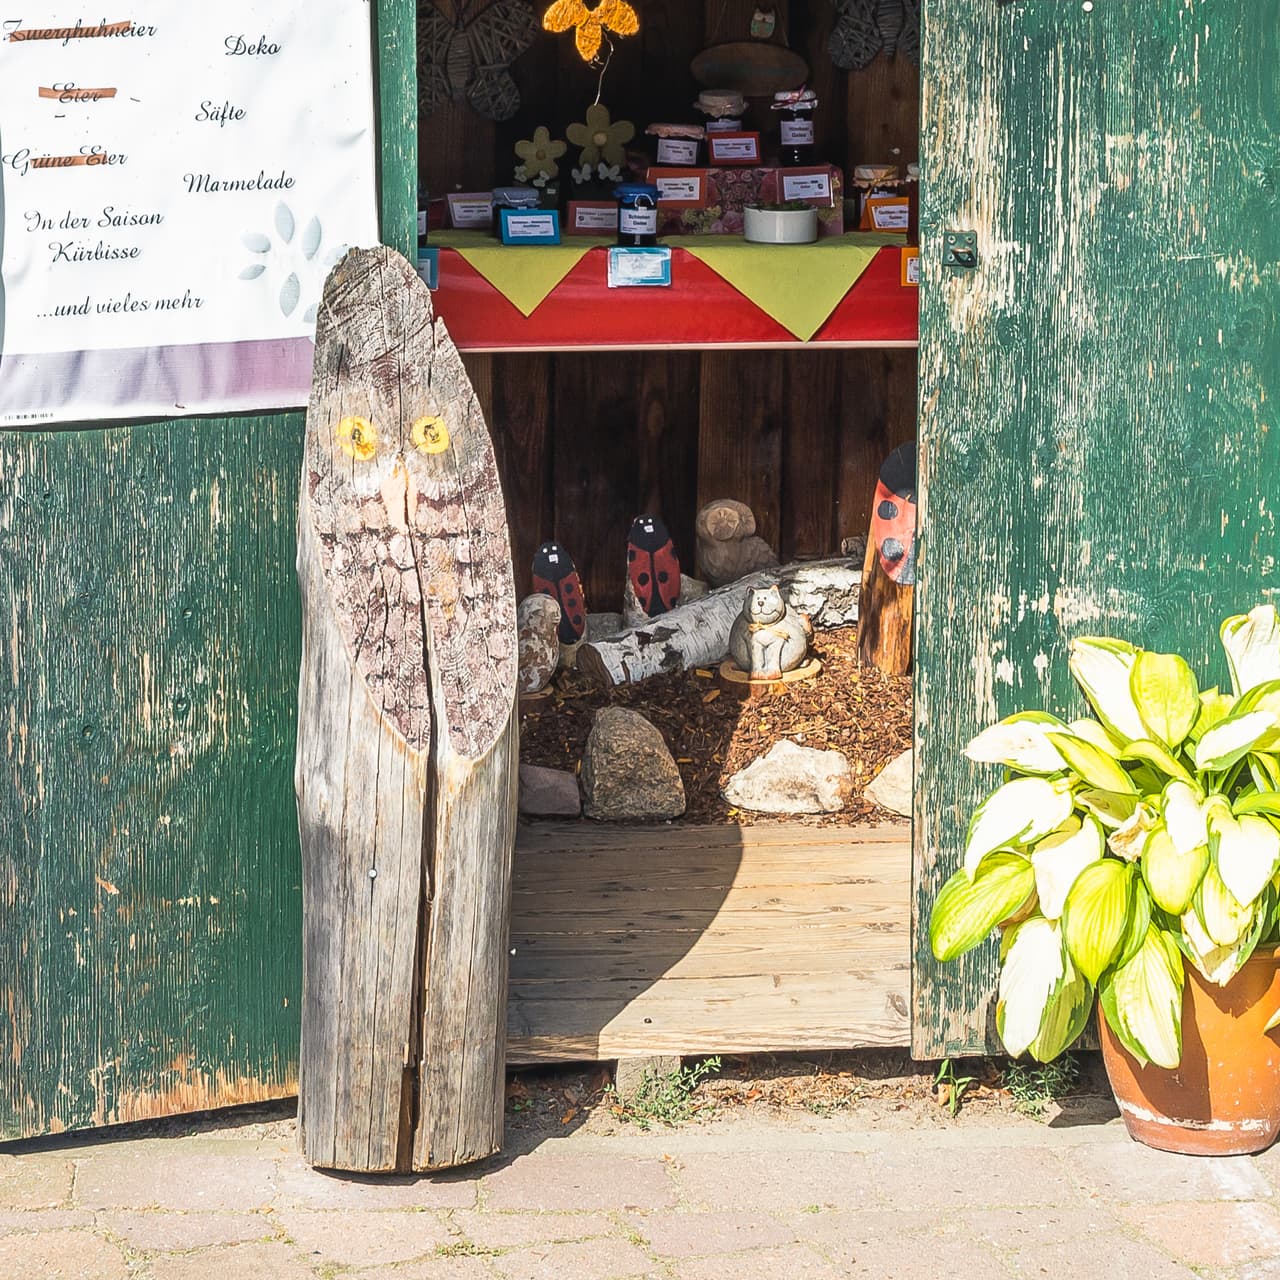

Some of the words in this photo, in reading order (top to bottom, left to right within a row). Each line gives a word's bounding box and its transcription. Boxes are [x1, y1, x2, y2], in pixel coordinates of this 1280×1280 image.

[224, 34, 282, 56] Deko
[52, 82, 102, 104] Eier
[195, 100, 247, 128] Säfte
[2, 148, 74, 176] Grüne
[80, 144, 128, 166] Eier
[184, 172, 296, 193] Marmelade
[24, 210, 55, 233] In
[59, 211, 91, 229] der
[97, 206, 164, 228] Saison
[48, 240, 141, 263] Kürbisse
[96, 293, 151, 314] vieles
[154, 289, 204, 310] mehr
